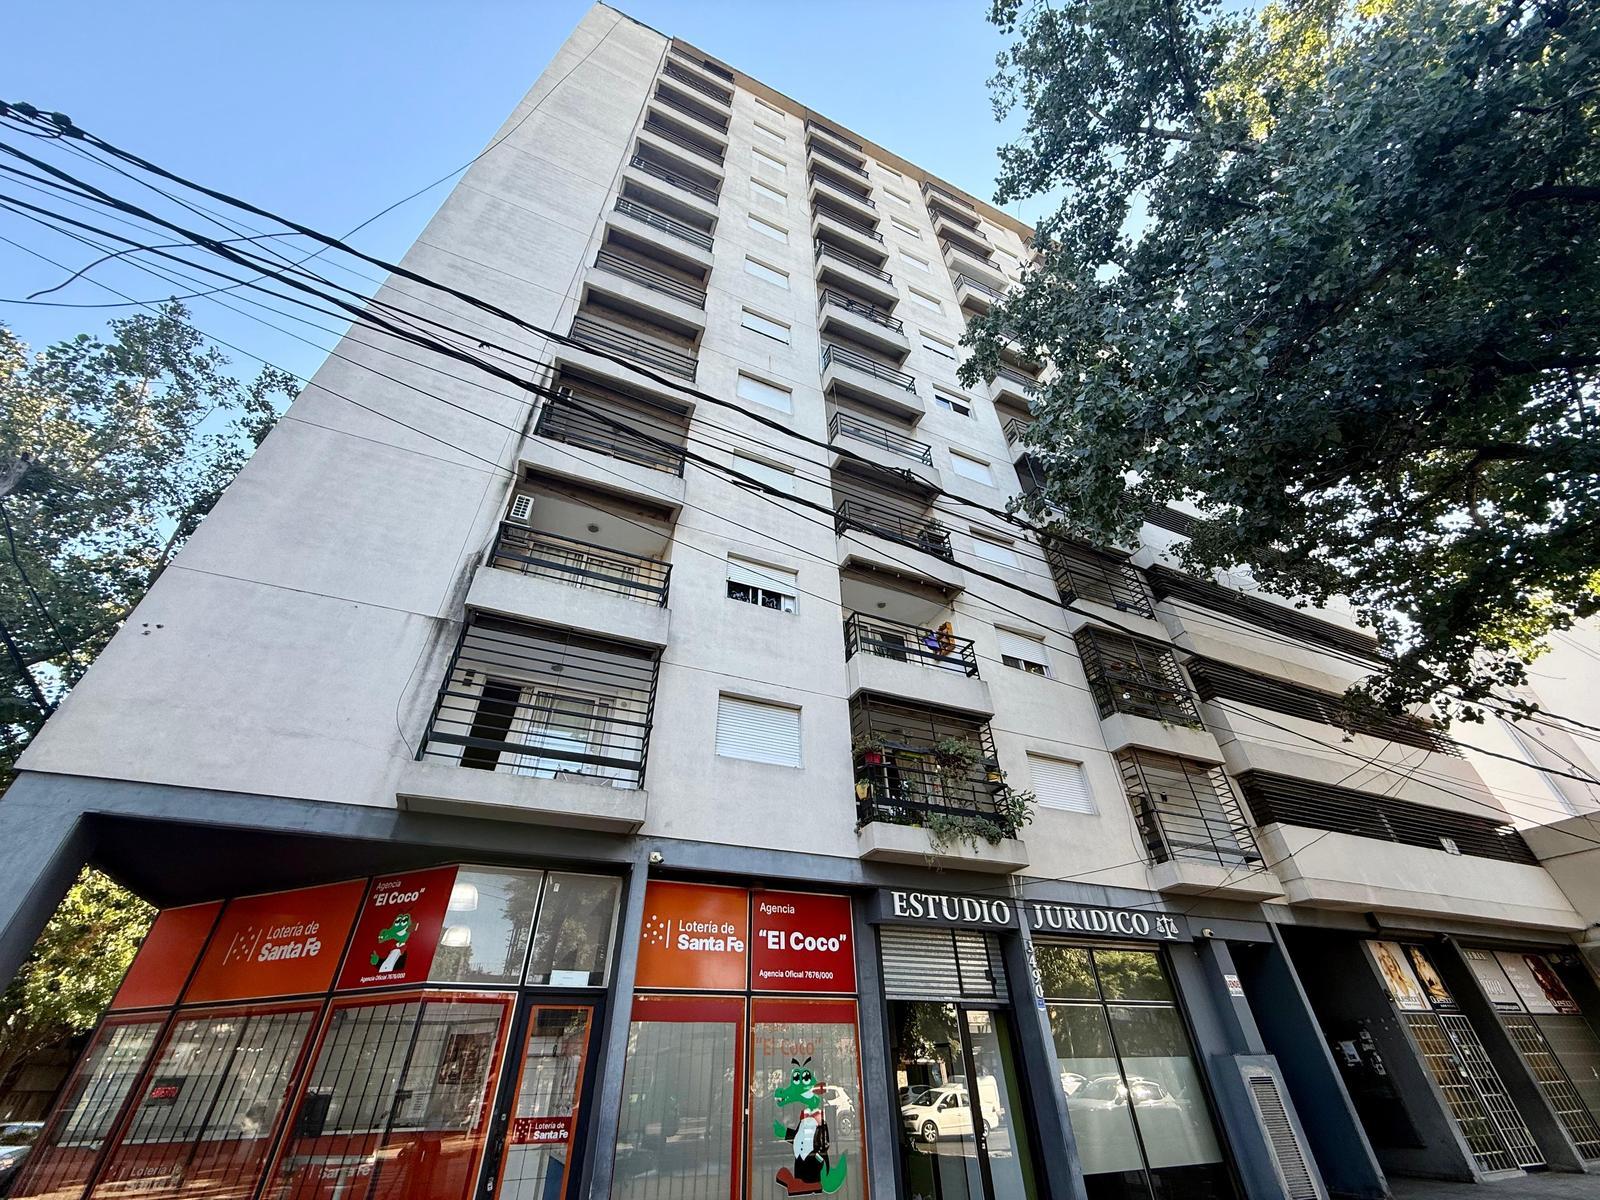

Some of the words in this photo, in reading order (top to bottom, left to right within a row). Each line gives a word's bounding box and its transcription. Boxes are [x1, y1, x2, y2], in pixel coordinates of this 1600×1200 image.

[376, 880, 402, 891] Agencia
[759, 902, 795, 914] Agencia
[890, 891, 1010, 925] ESTUDIO
[1033, 904, 1150, 936] JURIDICO
[266, 921, 304, 940] Lotería
[304, 920, 320, 935] de
[679, 919, 717, 934] Lotería
[721, 921, 735, 934] de
[257, 941, 303, 962] Santa
[301, 936, 322, 957] Fe
[677, 934, 727, 952] Santa
[727, 936, 745, 953] Fe
[759, 969, 784, 979] Agencia
[784, 970, 804, 978] Oficial
[804, 970, 834, 979] 7676/000
[1026, 940, 1044, 998] 3490
[533, 1130, 559, 1140] Santa
[559, 1129, 569, 1139] Fe
